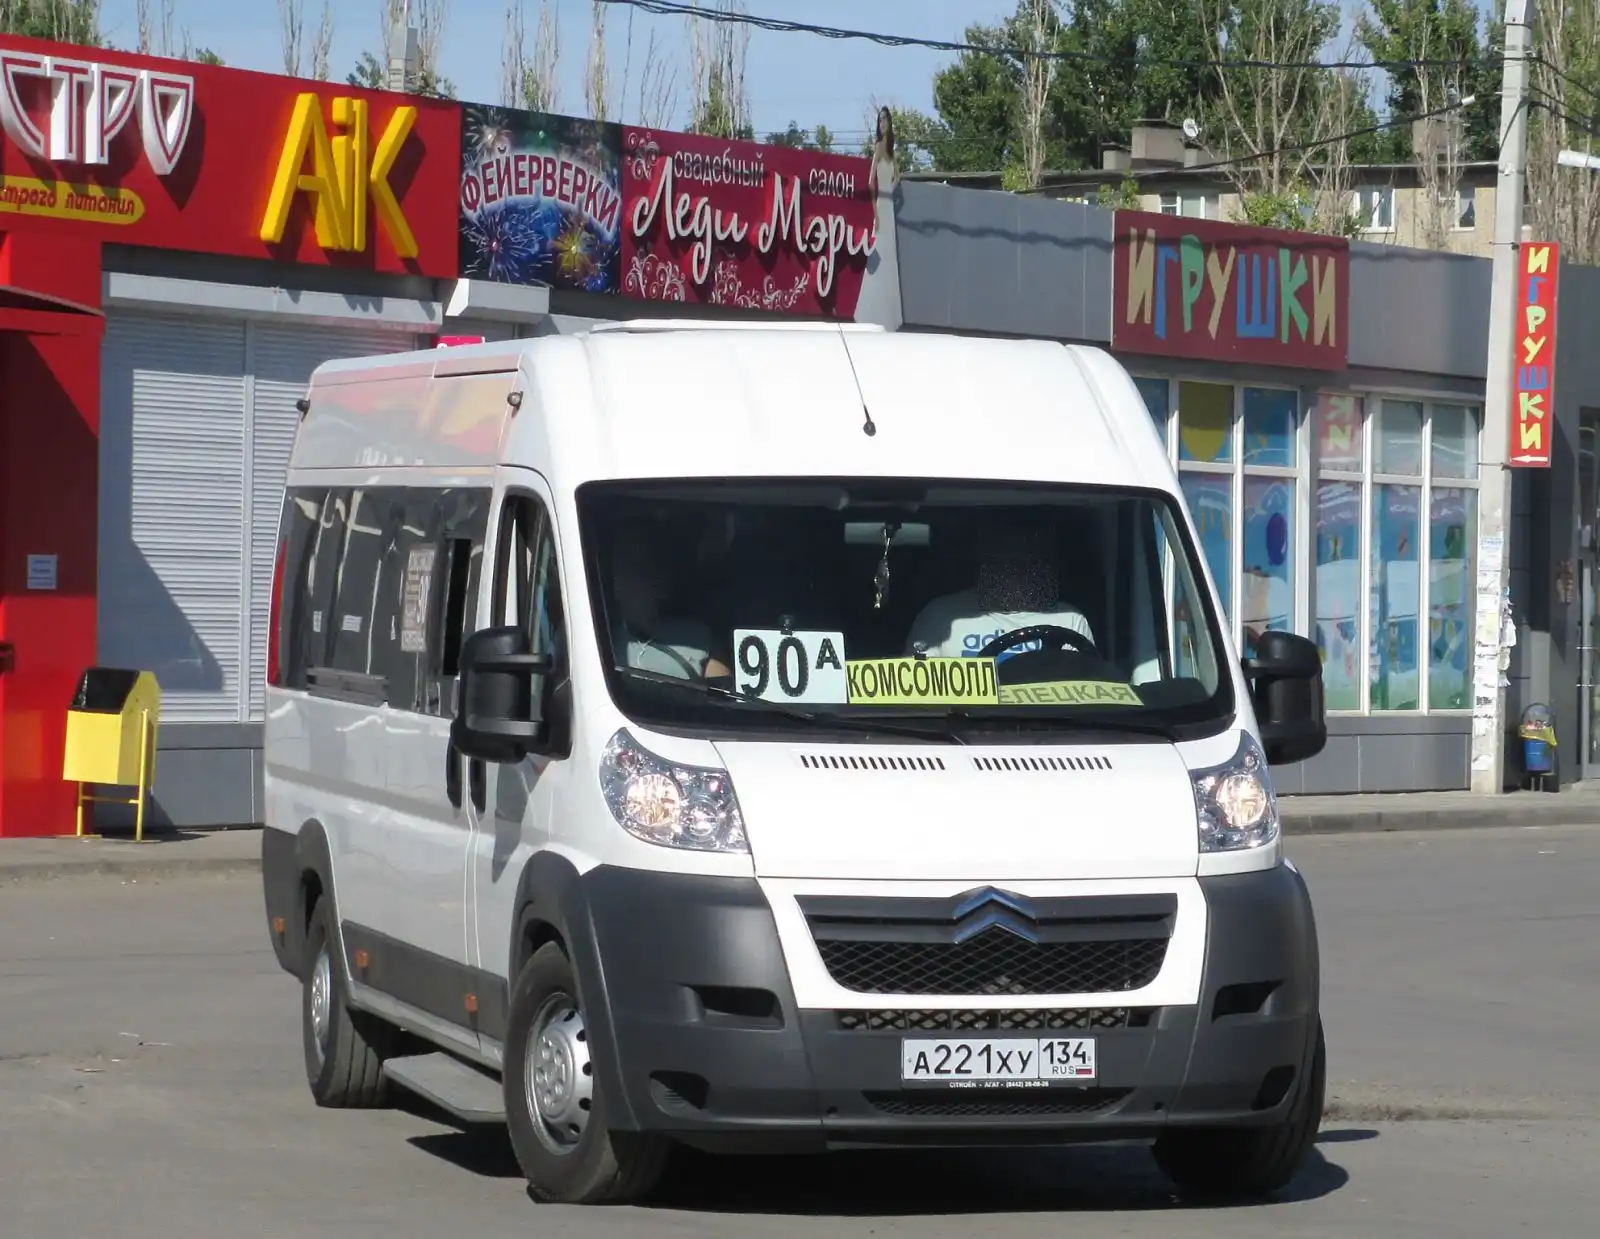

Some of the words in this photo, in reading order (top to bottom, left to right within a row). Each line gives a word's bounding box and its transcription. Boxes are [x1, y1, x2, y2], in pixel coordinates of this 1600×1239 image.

[462, 146, 619, 232] ФЕЙЕРВЕРКИ
[673, 149, 764, 188] свадебный
[809, 168, 855, 198] салон
[633, 156, 748, 285] Леди
[758, 171, 877, 298] Мэри
[1127, 228, 1336, 347] ИГРУШКИ
[1518, 246, 1550, 450] ИГРУШКИ
[847, 661, 996, 697] КОМСОМОЛЛ
[1042, 1041, 1087, 1065] 134
[1052, 1066, 1075, 1075] RUS
